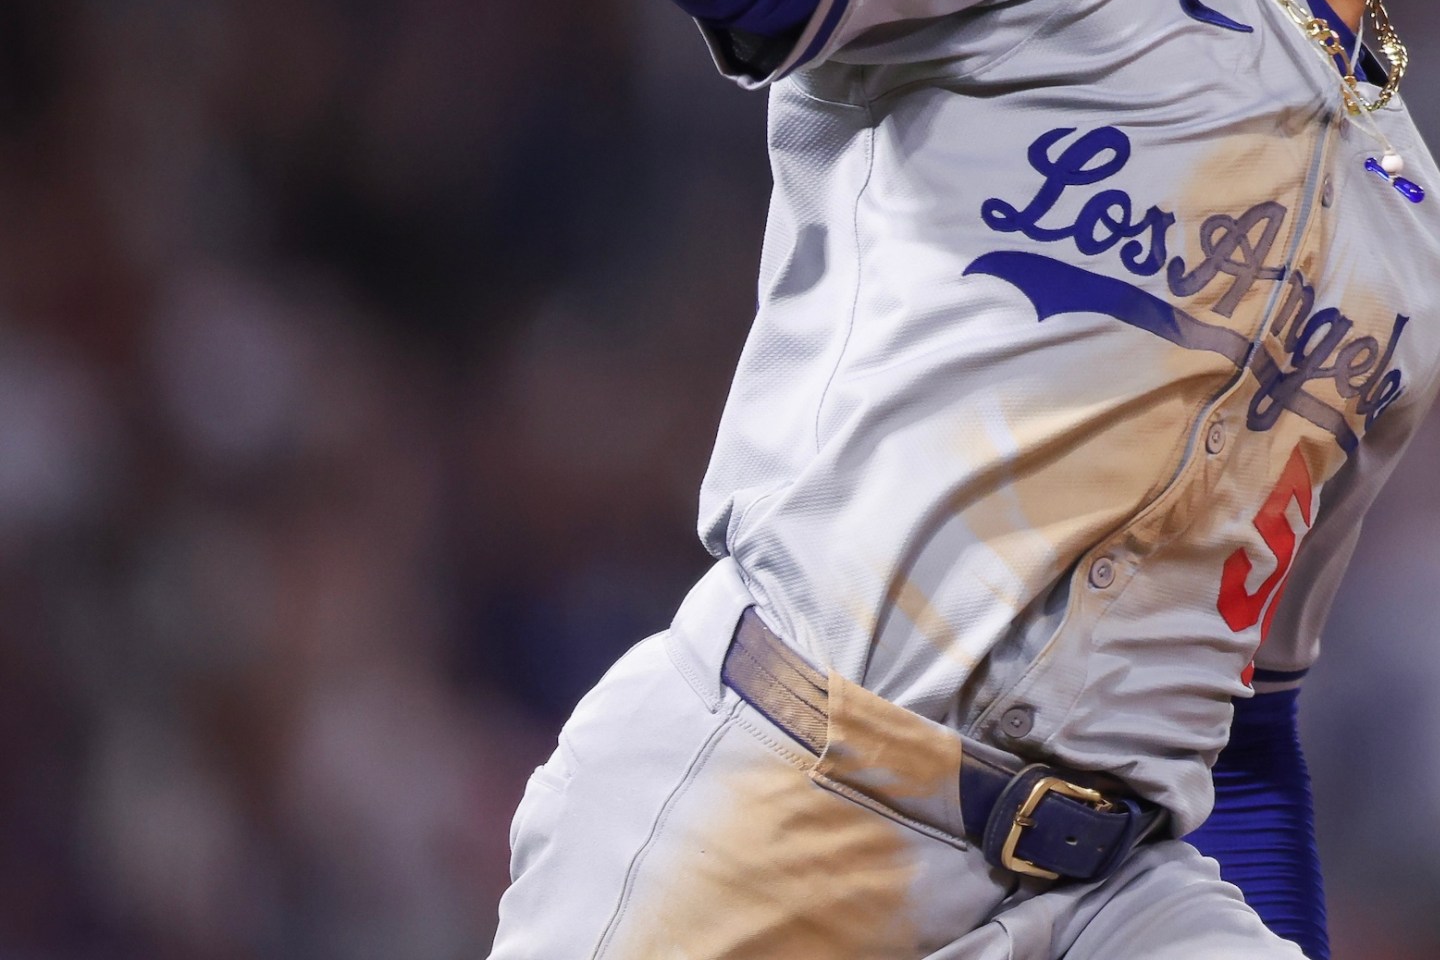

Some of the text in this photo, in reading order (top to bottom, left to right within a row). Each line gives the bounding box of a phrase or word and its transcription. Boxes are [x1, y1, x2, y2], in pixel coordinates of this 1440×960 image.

[981, 126, 1410, 432] Los Angele
[1216, 442, 1312, 688] 5
